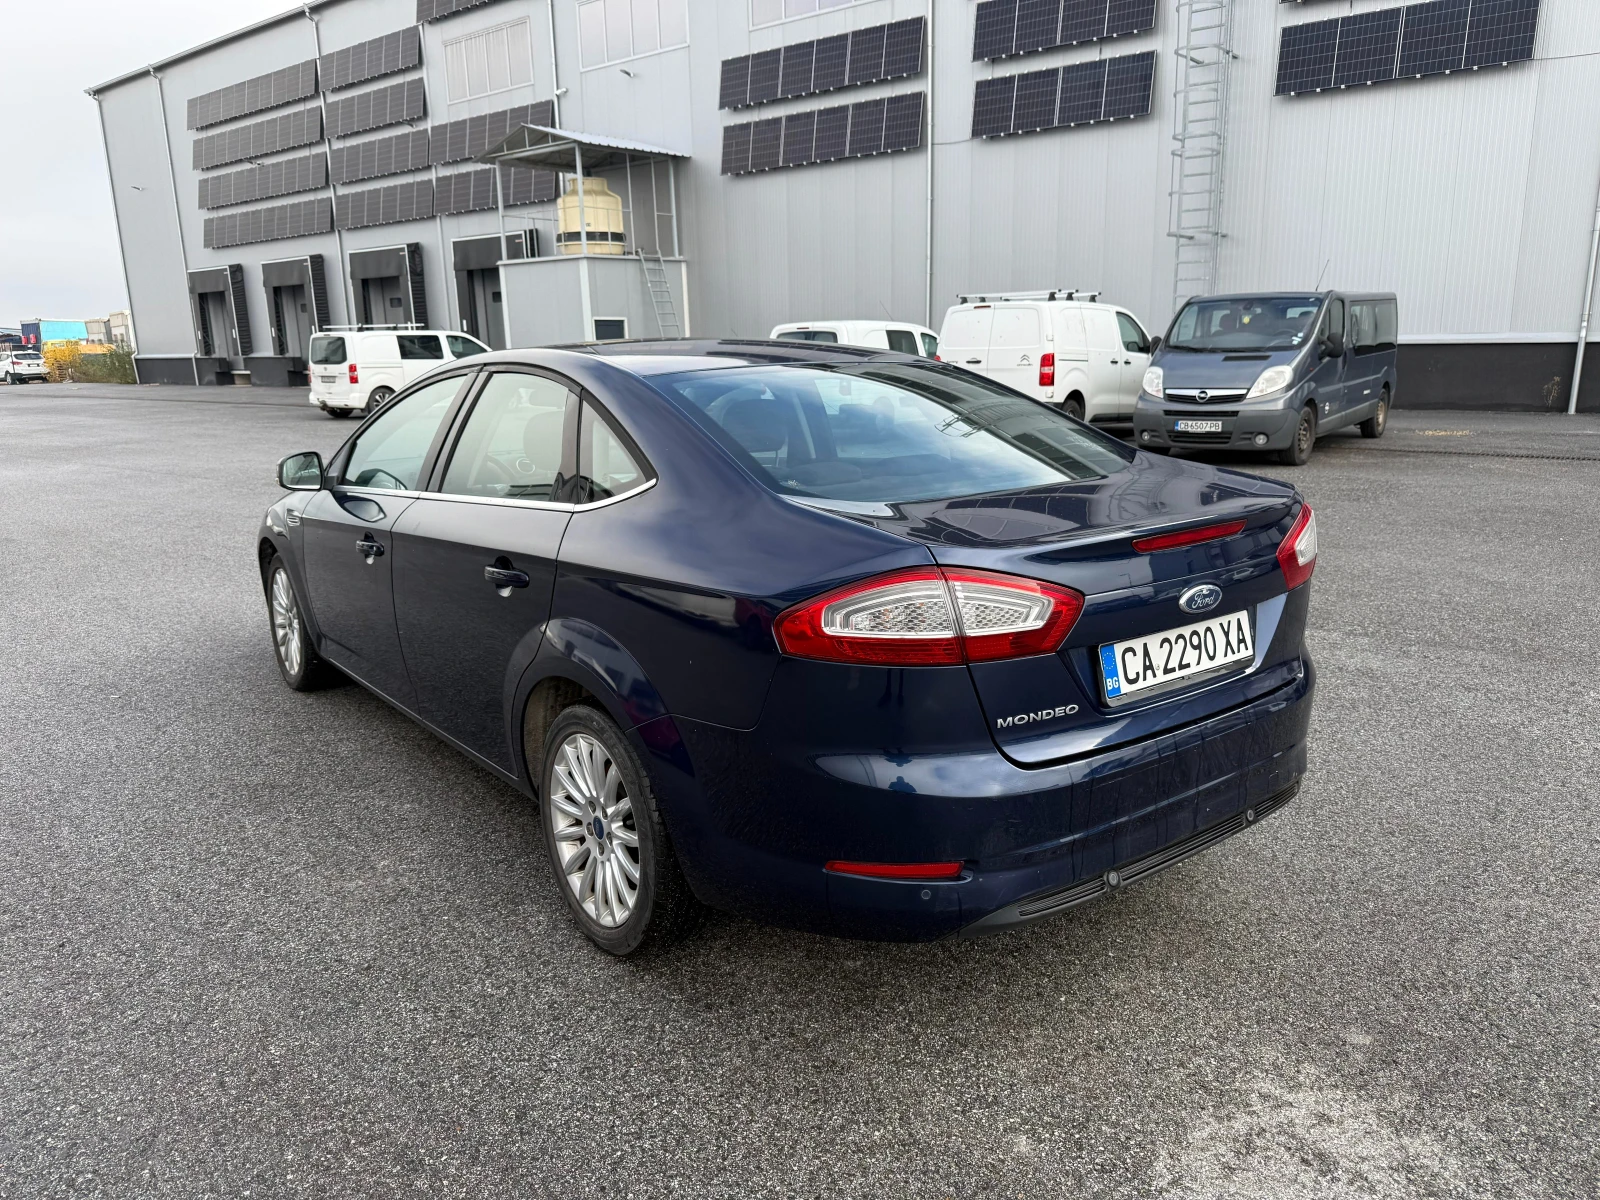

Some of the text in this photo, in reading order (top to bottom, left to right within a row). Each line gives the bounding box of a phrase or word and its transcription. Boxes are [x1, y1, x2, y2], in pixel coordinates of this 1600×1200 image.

[1190, 422, 1209, 430] 6507
[1191, 589, 1216, 609] Ford
[1121, 617, 1249, 685] CA 2290 XA
[1106, 677, 1119, 690] BG
[996, 704, 1079, 729] MONDEO
